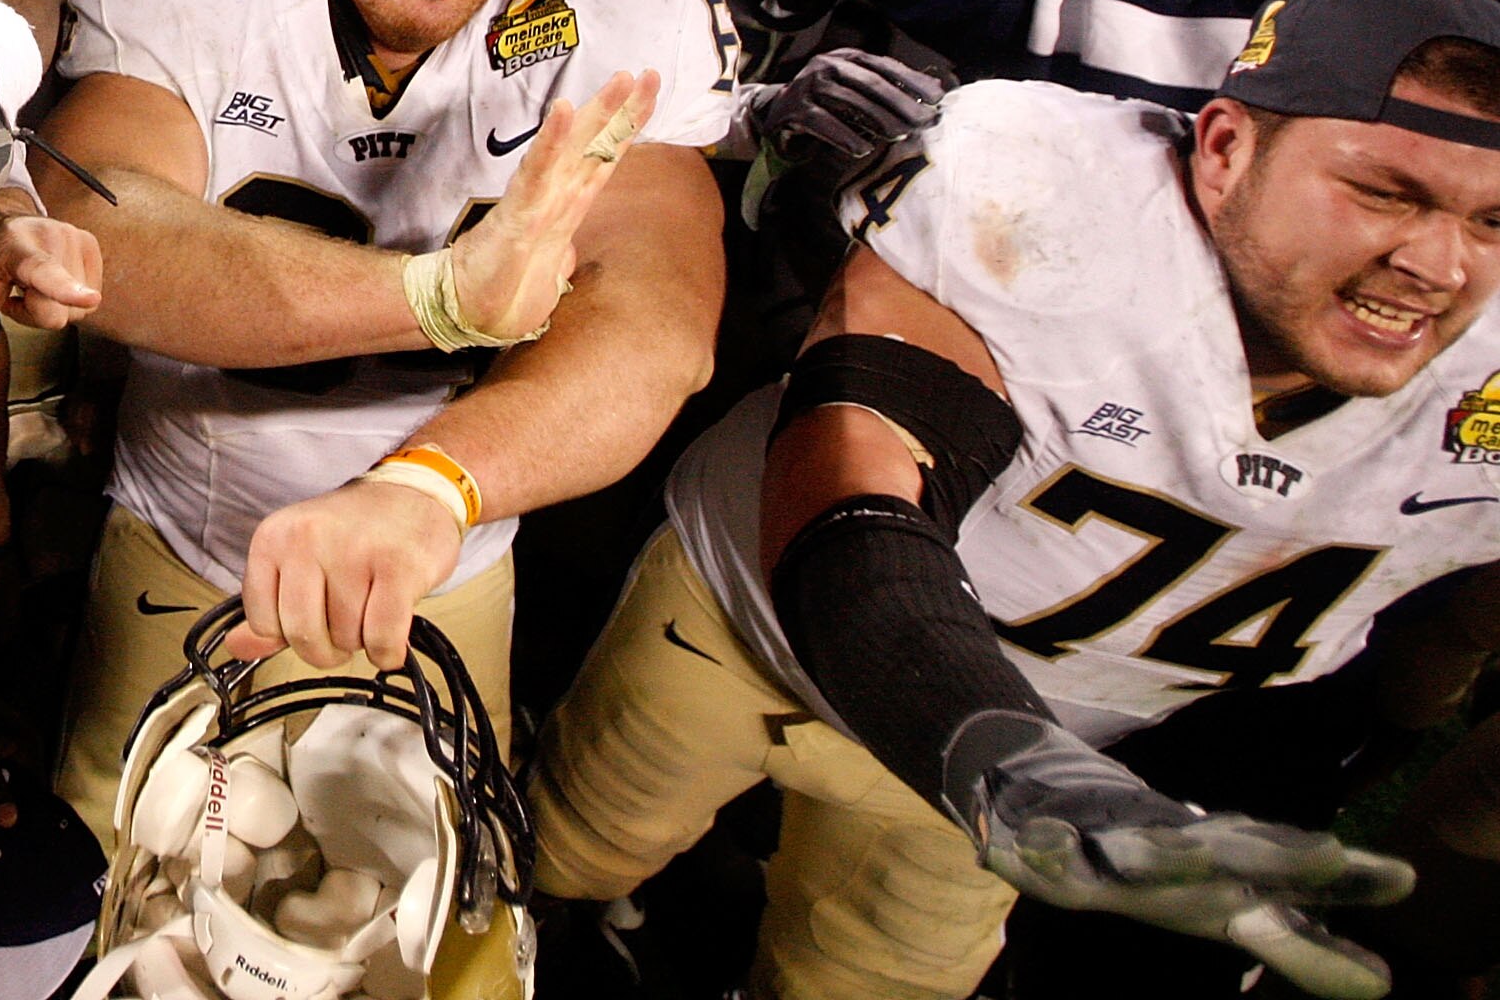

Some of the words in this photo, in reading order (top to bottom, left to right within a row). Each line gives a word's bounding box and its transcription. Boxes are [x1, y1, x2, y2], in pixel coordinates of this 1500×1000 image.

[504, 15, 570, 46] meineke
[511, 40, 531, 54] car
[534, 30, 563, 47] care
[503, 41, 571, 78] BOWL
[232, 91, 273, 112] BIG
[219, 105, 285, 130] EAST
[348, 131, 417, 162] PITT
[1081, 416, 1149, 443] EAST
[1095, 402, 1142, 426] BIG
[1236, 453, 1302, 497] PITT
[993, 462, 1393, 690] 74
[205, 752, 228, 833] Riddell
[235, 954, 288, 992] Riddell
